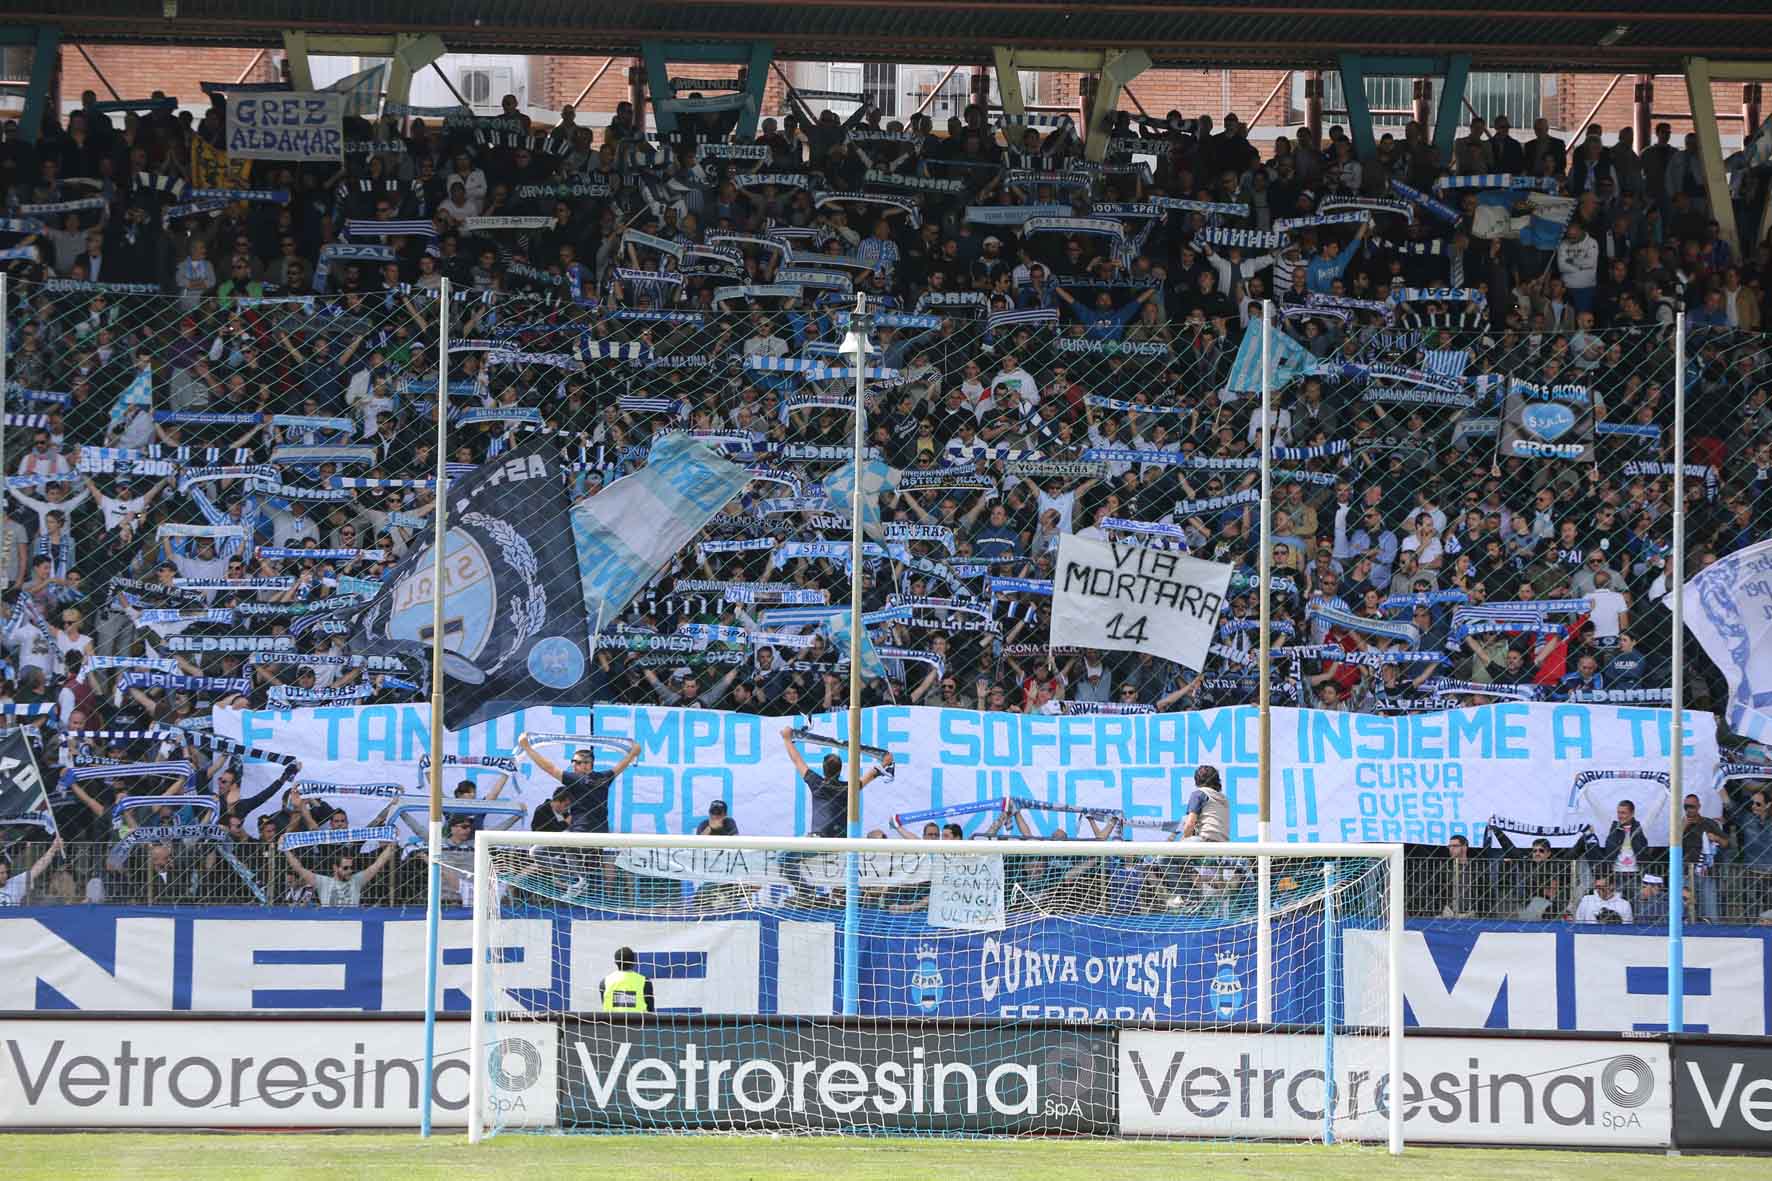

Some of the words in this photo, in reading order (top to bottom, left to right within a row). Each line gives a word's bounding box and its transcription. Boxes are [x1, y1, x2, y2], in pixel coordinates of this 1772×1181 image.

[229, 127, 342, 156] ALDAMAR
[1512, 439, 1585, 459] GROUP
[1109, 540, 1178, 577] VIA
[1063, 562, 1222, 625] MORTARA
[1248, 574, 1299, 593] OEST
[168, 637, 293, 652] ALDAMAR
[1105, 613, 1148, 645] 14
[939, 706, 1261, 767] SOFFRIAMO
[1298, 703, 1530, 765] INSIEME
[1551, 704, 1593, 760] A
[1616, 708, 1696, 758] TE
[1355, 763, 1464, 789] CURVA
[1357, 792, 1464, 820] OVEST
[629, 848, 751, 876] GIUSTIZIA
[980, 936, 1079, 1002] CURVA
[1084, 943, 1179, 1008] OVEST
[6, 1039, 473, 1112] Vetroresina
[487, 1095, 527, 1113] SpA
[574, 1043, 1040, 1116] Vetroresina
[1044, 1098, 1083, 1119] SpA
[1128, 1049, 1596, 1127] Vetroresina
[1601, 1110, 1642, 1129] SpA
